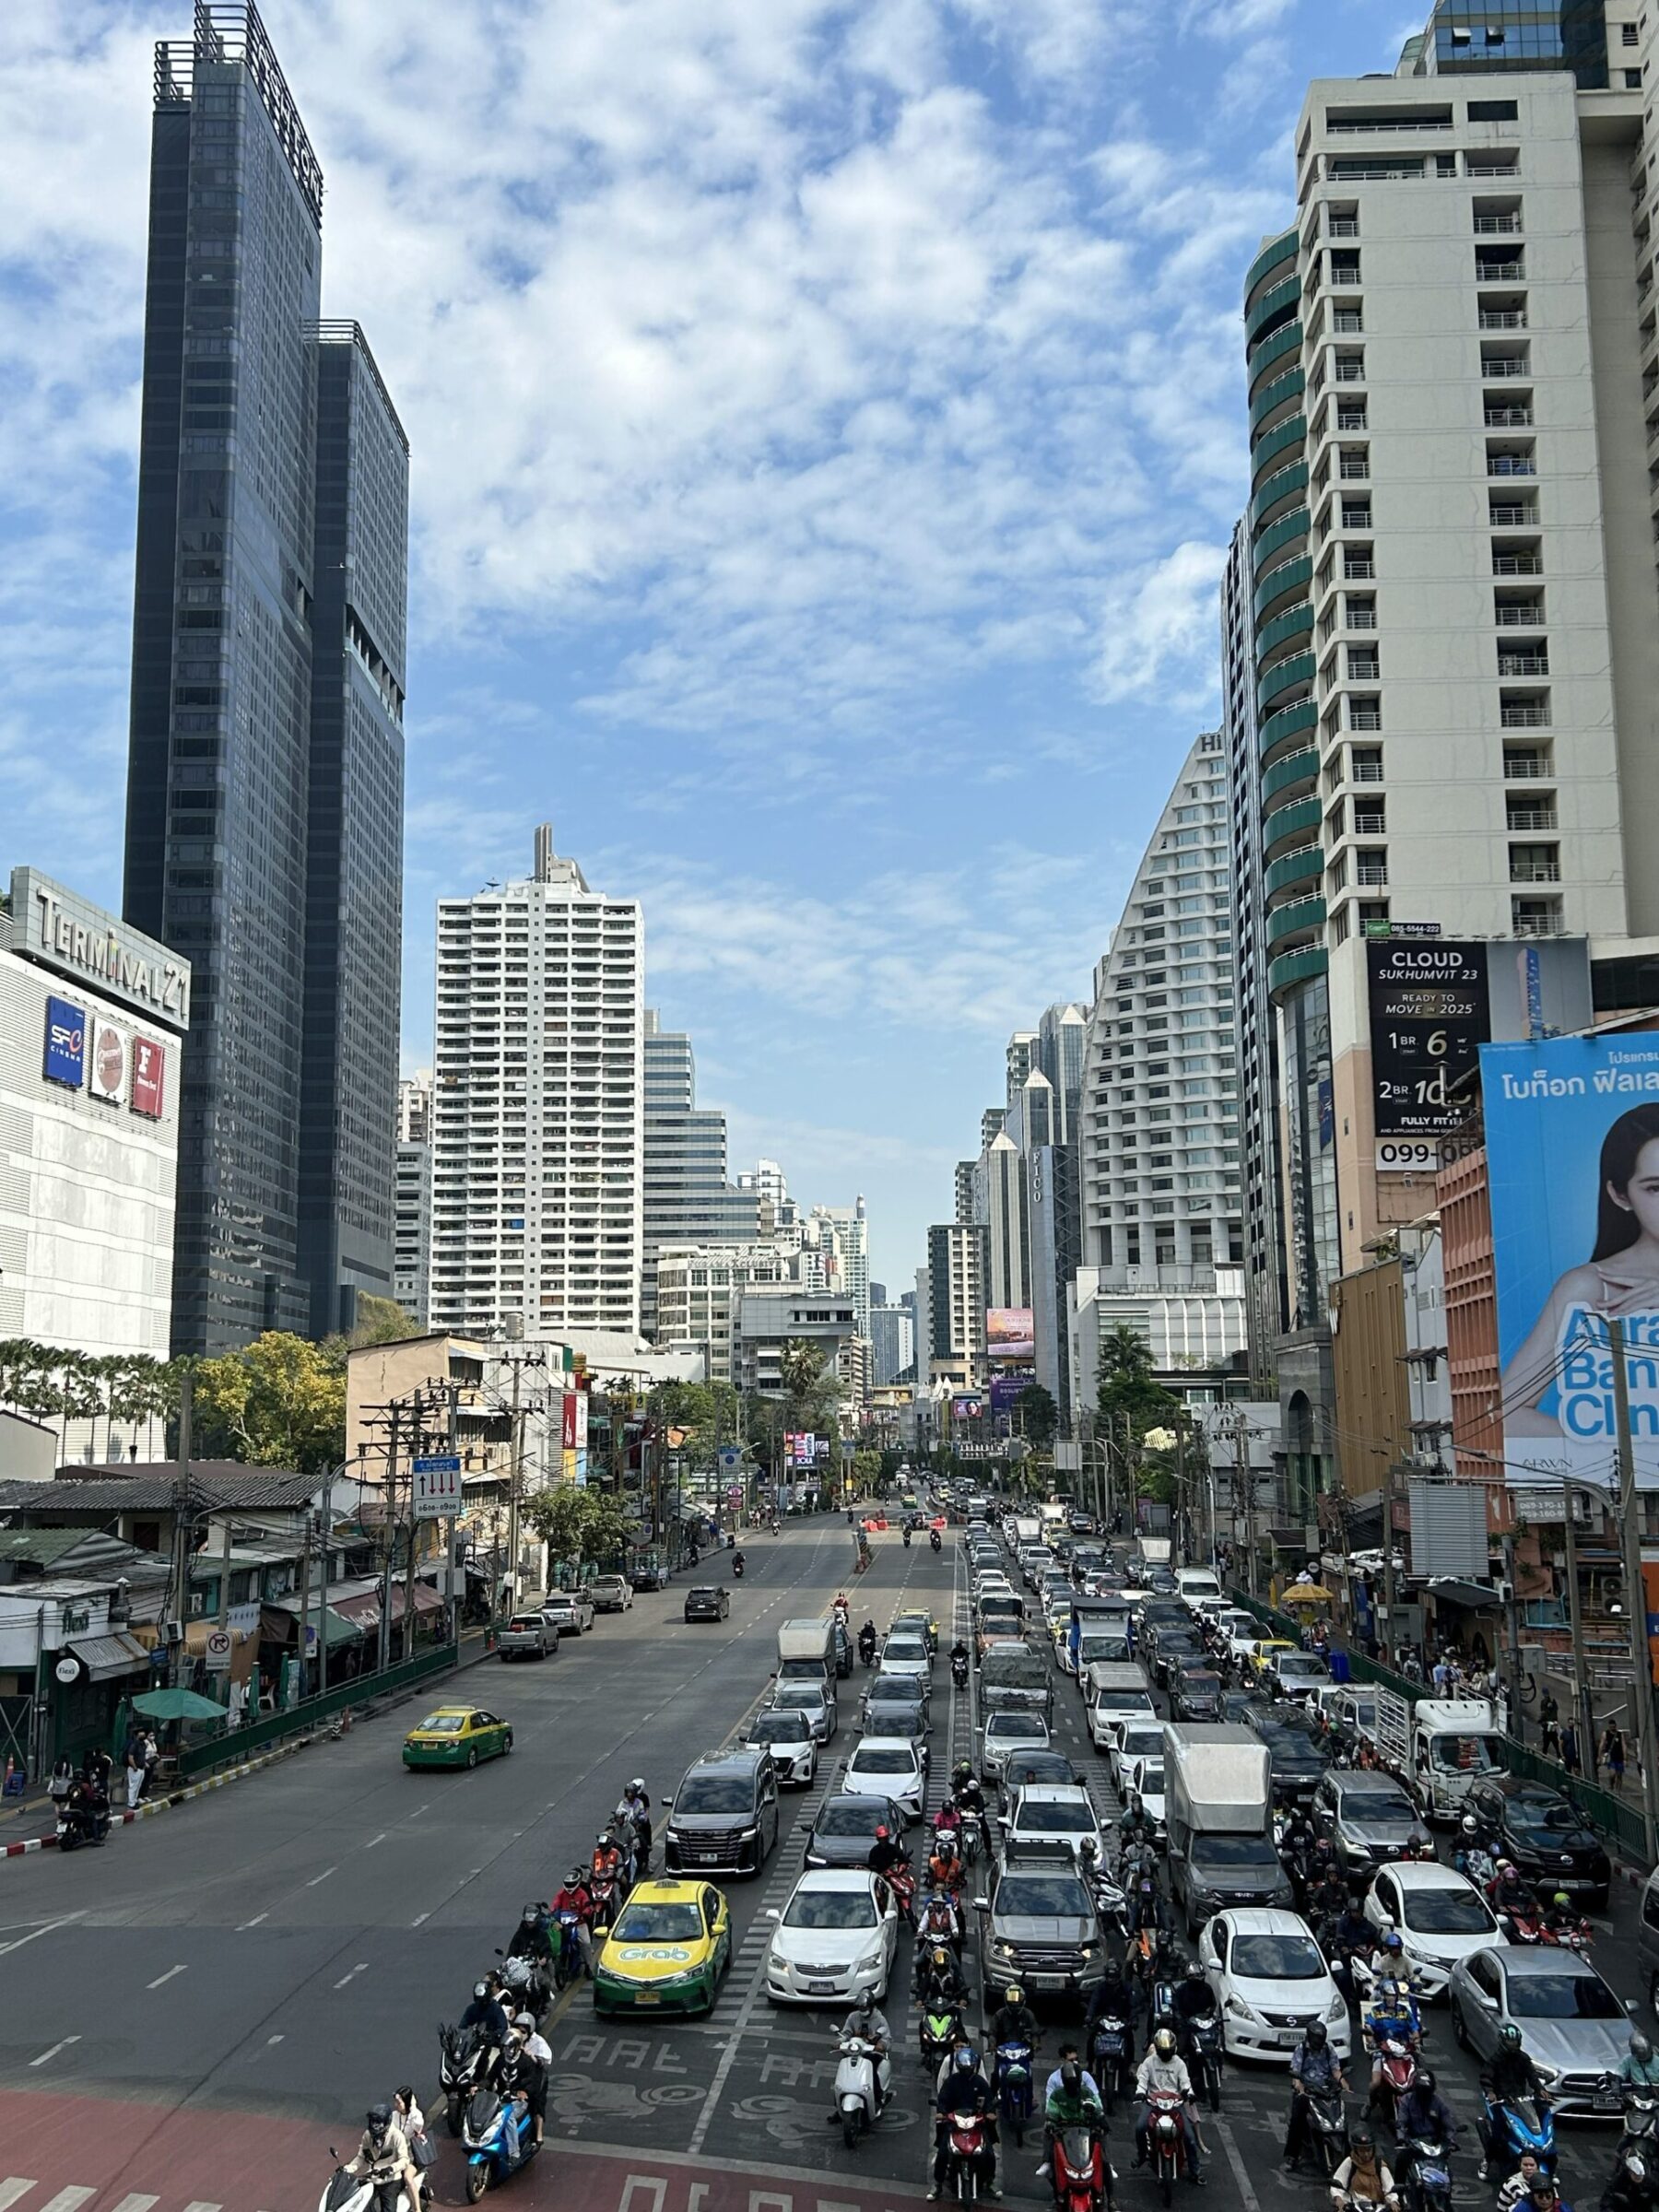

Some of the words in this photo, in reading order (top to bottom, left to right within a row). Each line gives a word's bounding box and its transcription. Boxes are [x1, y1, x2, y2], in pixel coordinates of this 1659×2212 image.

[1392, 952, 1463, 967] CLOUD
[1379, 970, 1457, 980] SUKHUMVIT
[1461, 970, 1477, 980] 23
[163, 961, 189, 1017] 21
[1385, 1005, 1423, 1014] MOVE
[1389, 1032, 1397, 1049] 1
[1427, 1030, 1447, 1055] 6
[1380, 1081, 1392, 1098] 2
[1501, 1069, 1585, 1100] โบท็อก
[619, 1947, 691, 1961] Grab
